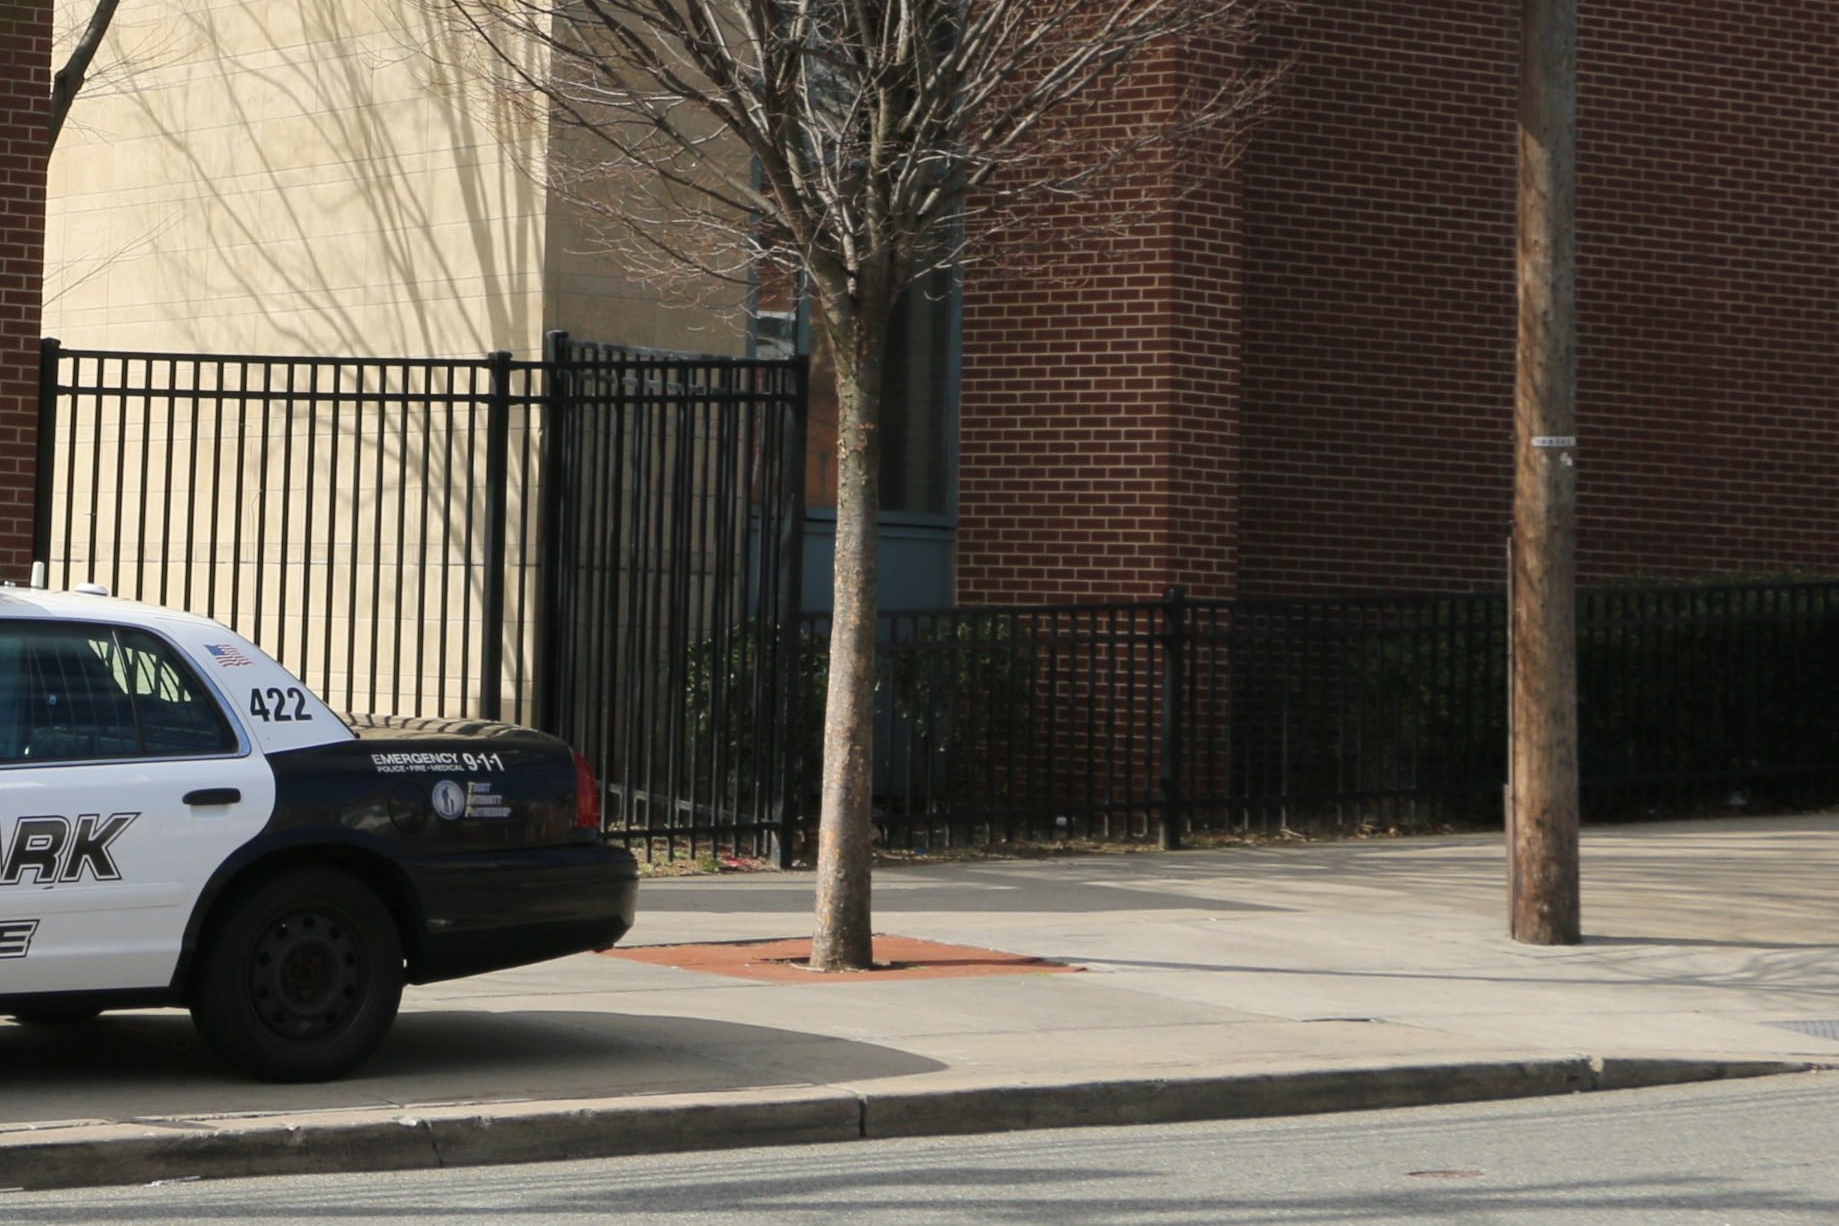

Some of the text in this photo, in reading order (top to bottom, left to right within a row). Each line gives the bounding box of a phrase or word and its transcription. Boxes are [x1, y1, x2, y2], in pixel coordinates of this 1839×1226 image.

[249, 687, 313, 723] 422
[371, 753, 459, 766] EMERGENCY
[377, 765, 406, 773] POLICE
[431, 764, 464, 772] MEDICAL
